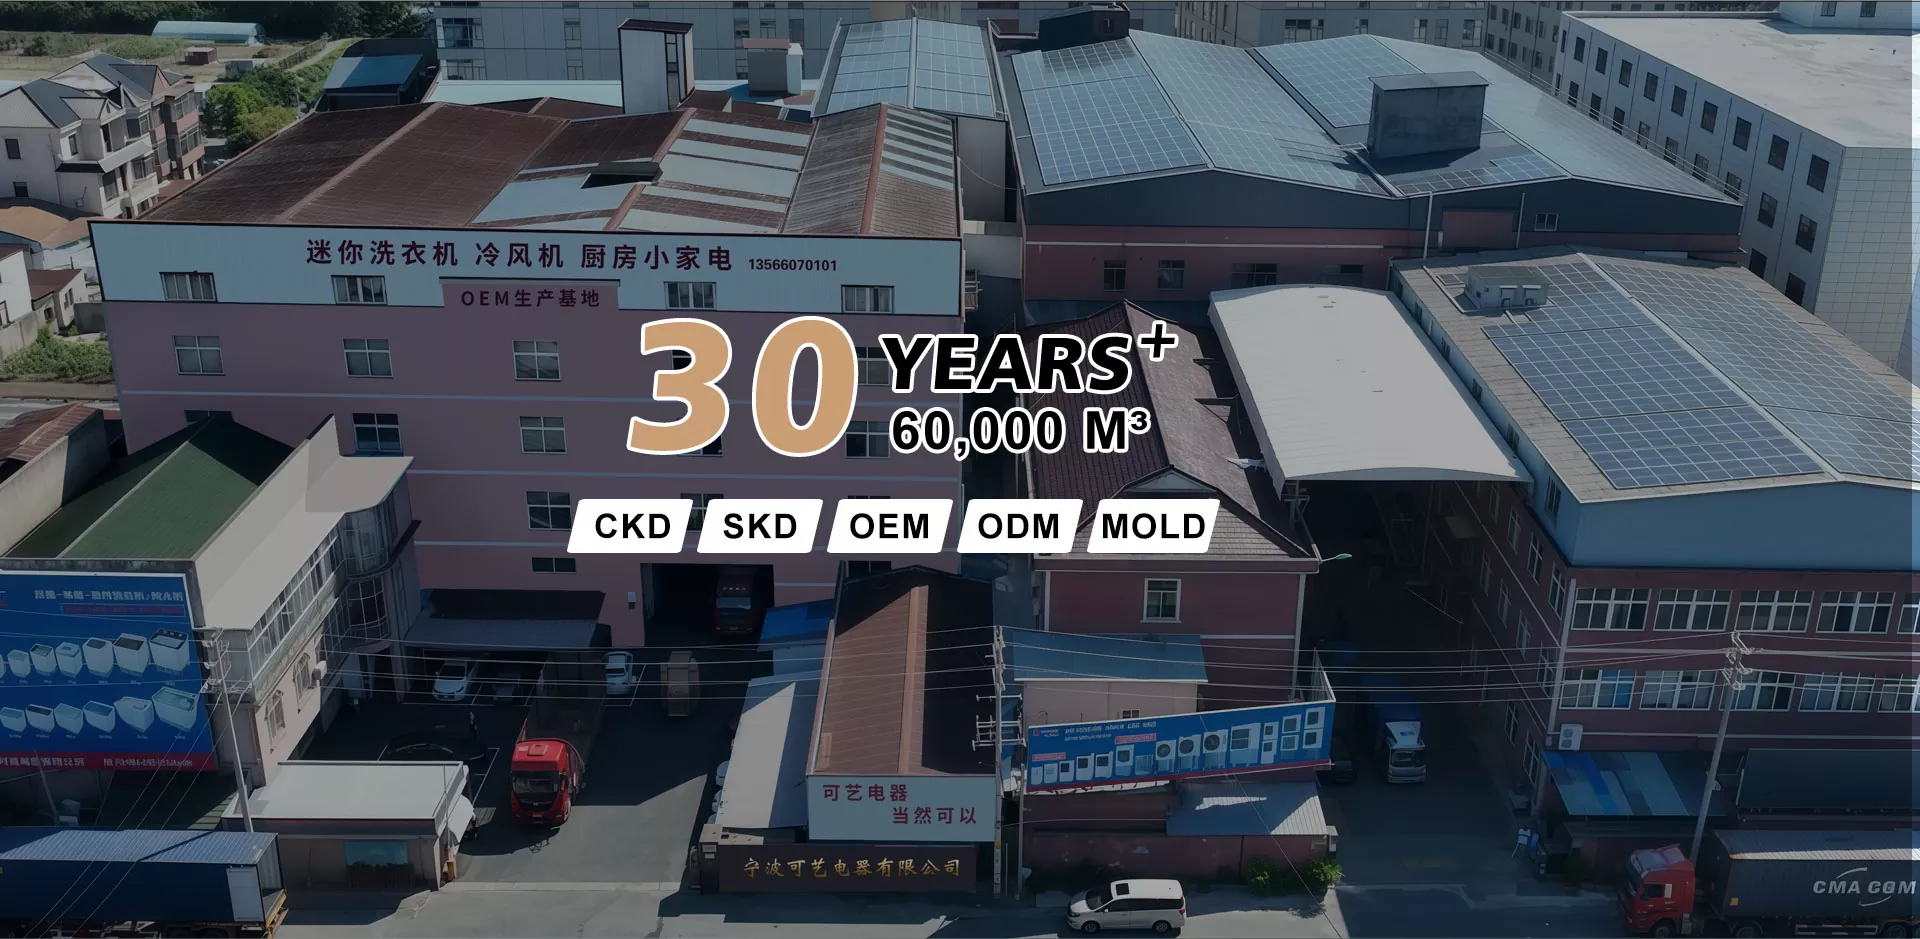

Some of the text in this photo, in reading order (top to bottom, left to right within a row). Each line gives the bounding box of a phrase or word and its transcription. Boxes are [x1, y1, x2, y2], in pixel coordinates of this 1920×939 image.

[306, 239, 838, 272] 迷你洗衣机 冷风机 厨房小家电 13566070101
[460, 289, 600, 308] OEM生产基地
[822, 784, 909, 802] 可艺电器
[892, 806, 977, 825] 当然可以
[743, 857, 961, 879] 宁波可艺电器有限公司
[1812, 880, 1861, 894] CMA
